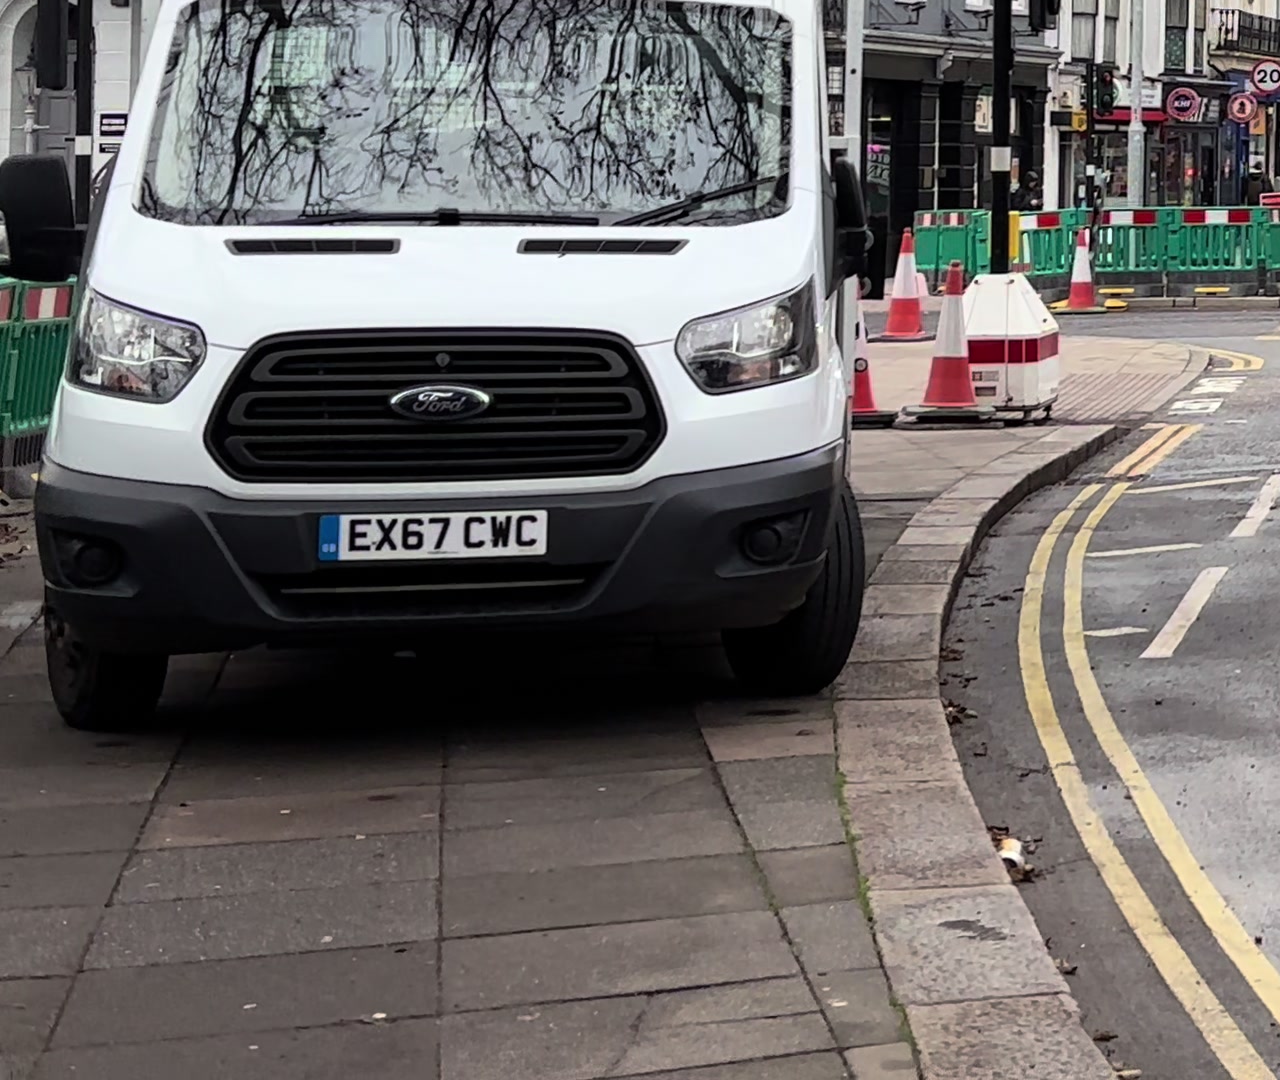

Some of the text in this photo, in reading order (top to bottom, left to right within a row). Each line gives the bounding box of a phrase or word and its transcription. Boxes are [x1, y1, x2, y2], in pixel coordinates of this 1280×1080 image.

[1257, 69, 1280, 84] 20
[412, 391, 466, 412] Ford
[348, 515, 538, 552] EX67 CWC
